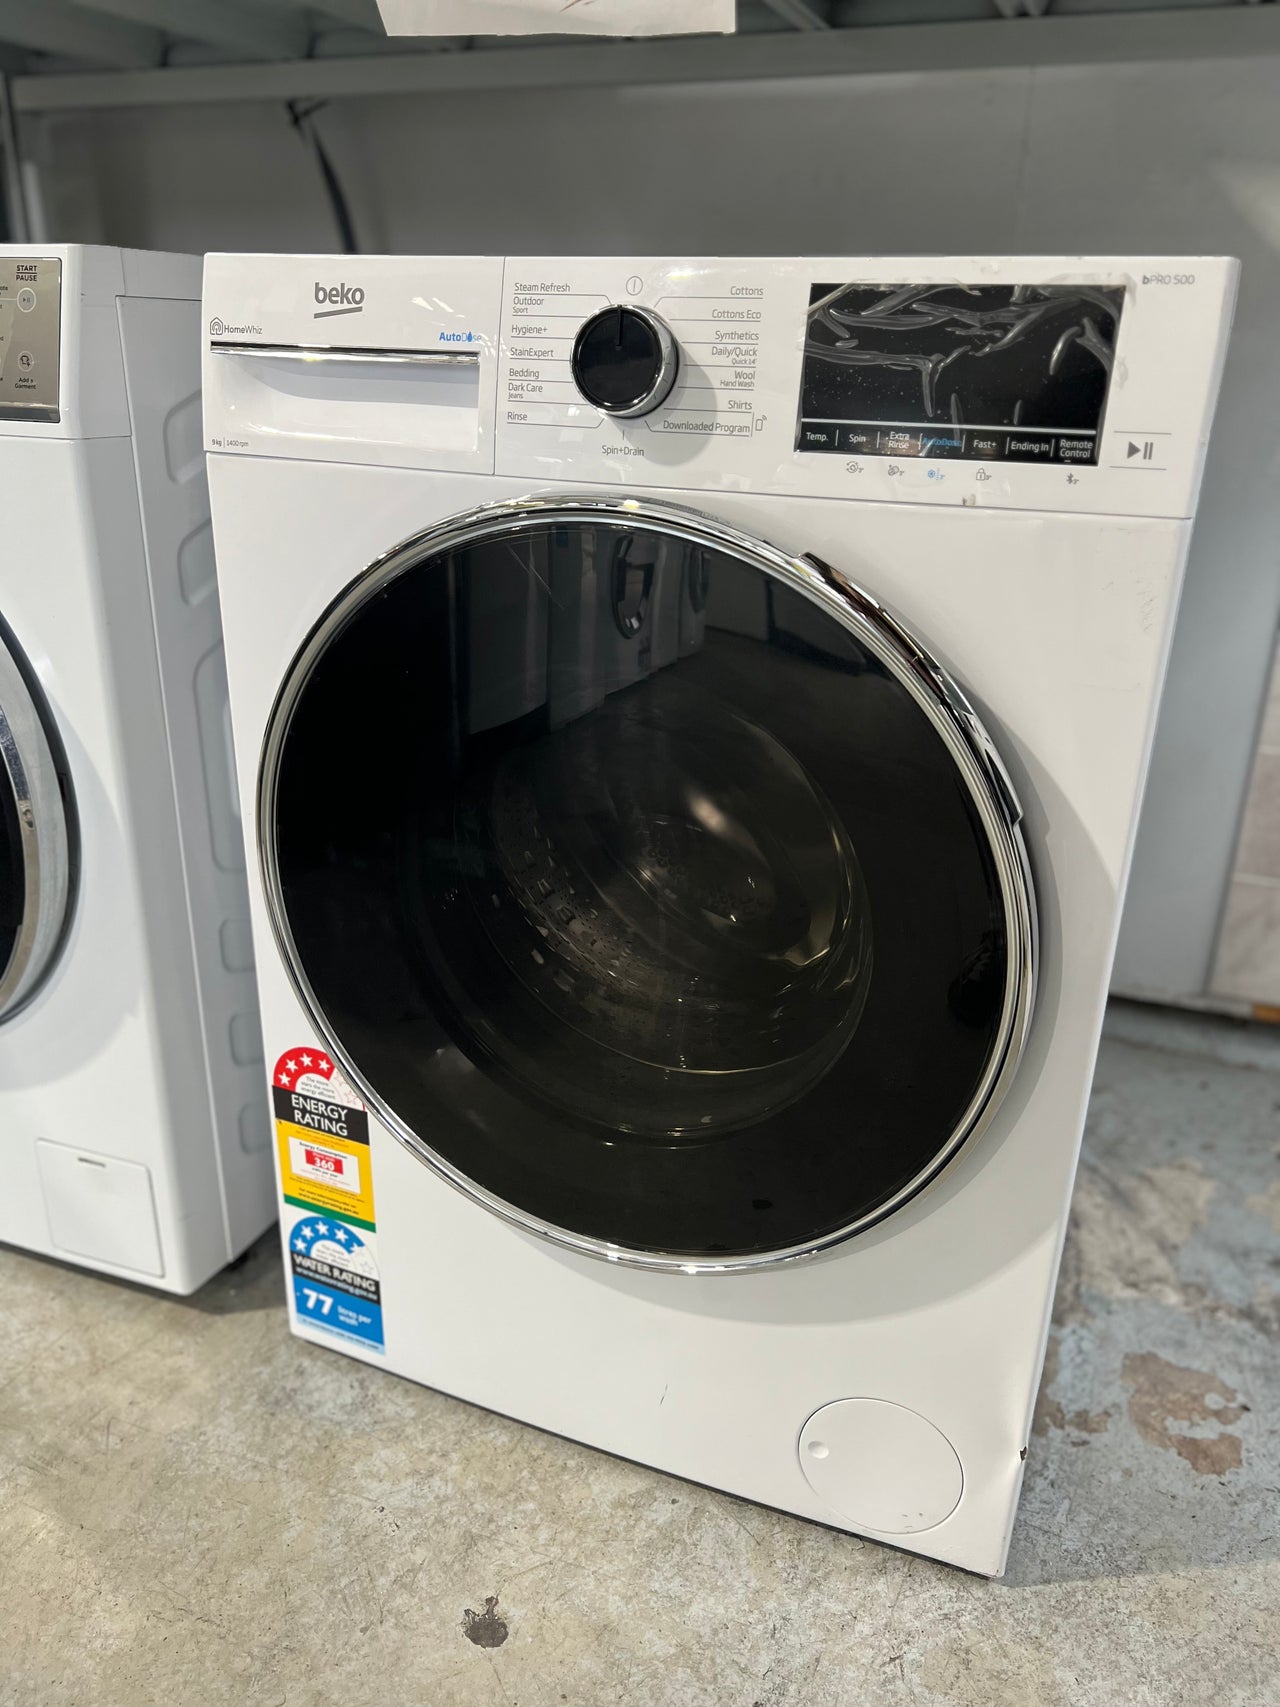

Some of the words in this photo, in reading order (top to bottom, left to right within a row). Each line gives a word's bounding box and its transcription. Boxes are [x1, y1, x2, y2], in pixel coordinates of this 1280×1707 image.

[16, 264, 38, 272] START
[15, 274, 38, 282] PAUSE
[1142, 274, 1172, 286] bPRO
[1173, 274, 1196, 286] 500
[514, 282, 539, 293] Steam
[540, 282, 571, 293] Refresh
[730, 286, 764, 297] Cottons
[314, 282, 365, 305] beko
[513, 296, 545, 306] Outdoor
[512, 306, 529, 314] Sport
[711, 308, 745, 320] Cottons
[746, 309, 762, 320] Eco
[224, 324, 263, 335] HomeWhiz
[511, 324, 548, 336] Hygiene+
[714, 330, 760, 343] Synthetics
[510, 346, 554, 358] StainExpert
[711, 346, 758, 359] Daily/Quick
[731, 357, 748, 366] Quick
[509, 367, 540, 379] Bedding
[734, 370, 756, 380] Wool
[508, 383, 525, 392] Dark
[526, 383, 544, 393] Care
[720, 379, 737, 388] Hand
[737, 380, 755, 388] Wash
[508, 392, 524, 400] Jeans
[727, 399, 753, 411] Shirts
[507, 411, 528, 421] Rinse
[663, 419, 714, 432] Downloaded
[715, 422, 751, 435] Program
[806, 431, 829, 443] Temp.
[848, 434, 867, 444] Spin
[889, 431, 911, 441] Extra
[226, 440, 240, 448] 1400
[888, 440, 910, 450] Rinse
[973, 439, 998, 449] Fast+
[1010, 441, 1040, 453] Ending
[1040, 443, 1050, 452] In
[1059, 439, 1094, 450] Remote
[601, 444, 645, 457] Spin+Drain
[1059, 448, 1092, 459] Control
[291, 1094, 348, 1121] ENERGY
[294, 1110, 348, 1136] RATING
[313, 1157, 336, 1172] 360
[293, 1253, 332, 1277] WATER
[332, 1266, 376, 1292] RATING
[302, 1287, 334, 1316] 77
